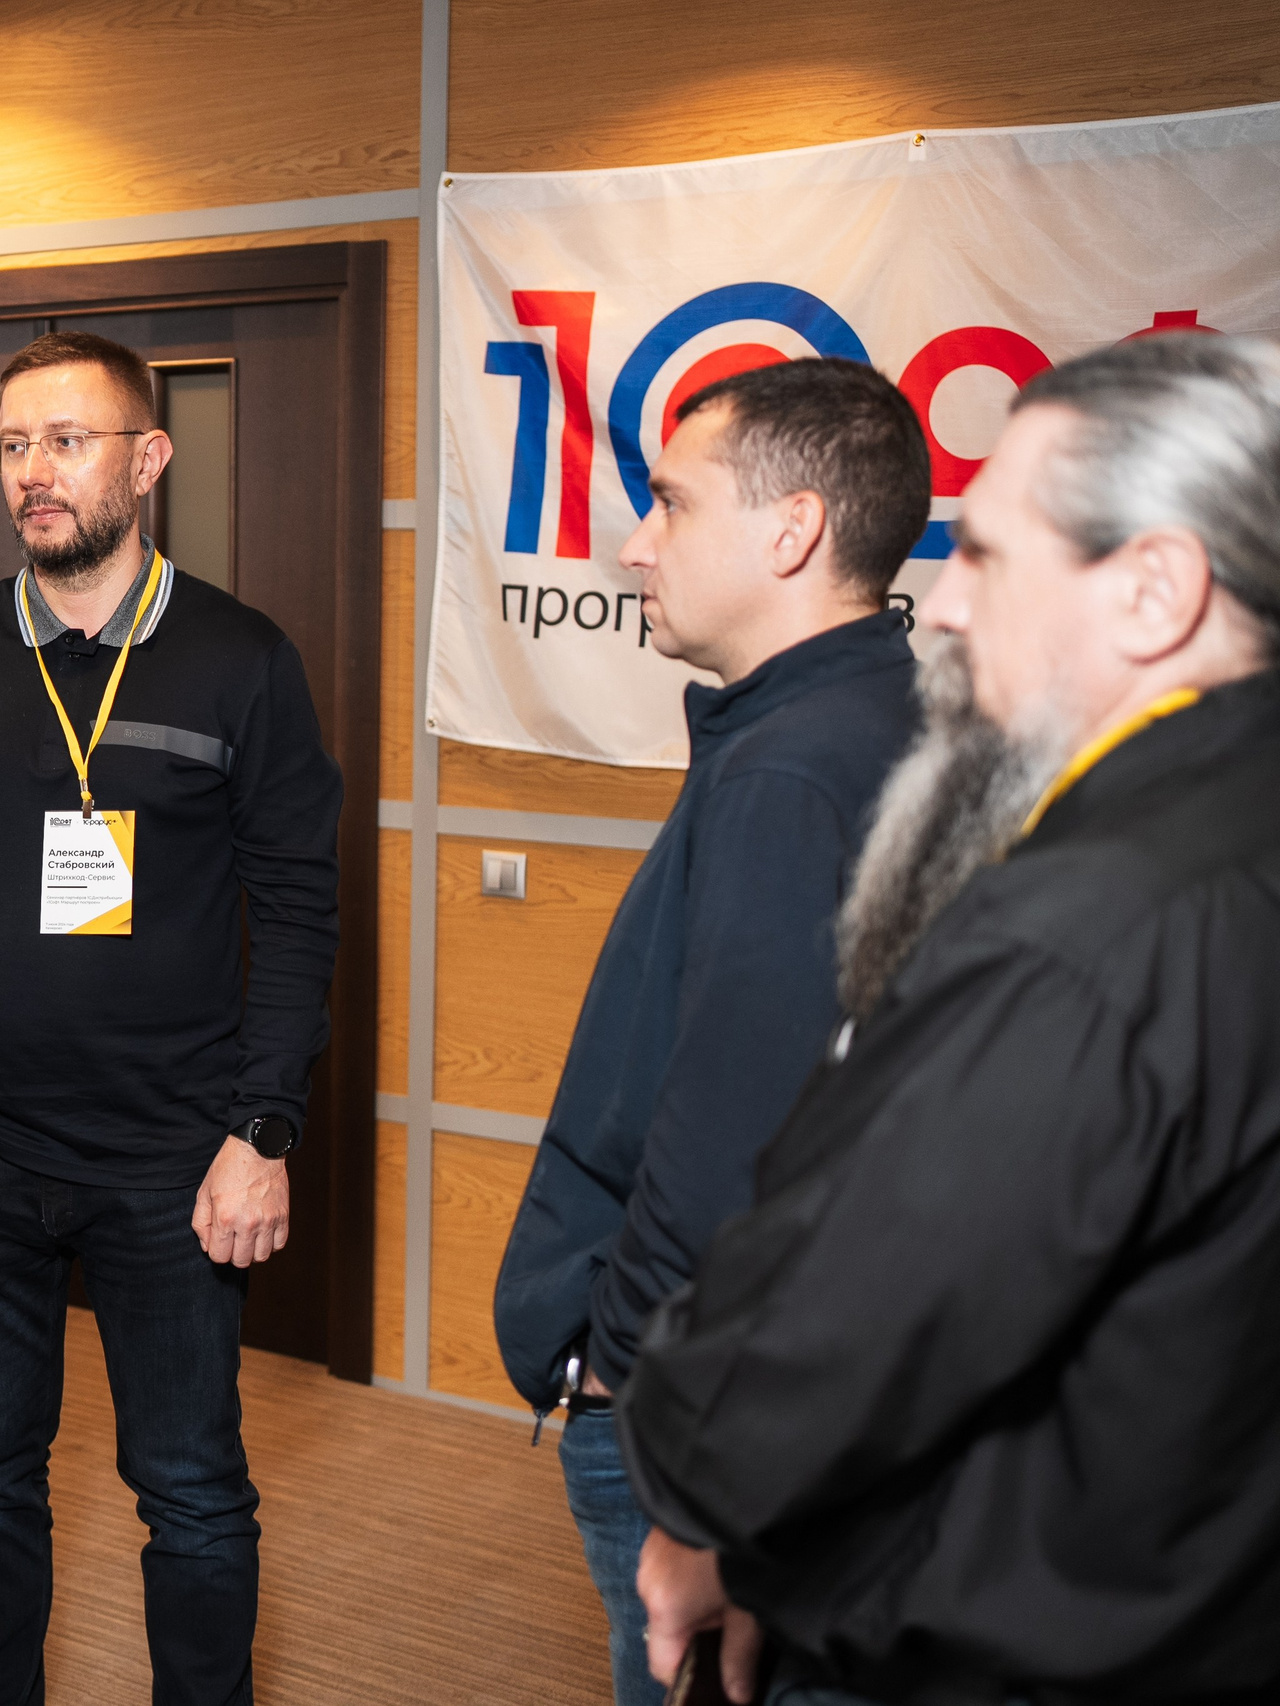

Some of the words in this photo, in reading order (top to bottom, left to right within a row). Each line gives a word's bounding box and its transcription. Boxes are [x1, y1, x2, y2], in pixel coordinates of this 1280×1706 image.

[123, 728, 157, 741] BOSS
[48, 849, 105, 858] Александр
[47, 860, 115, 870] Стабровский
